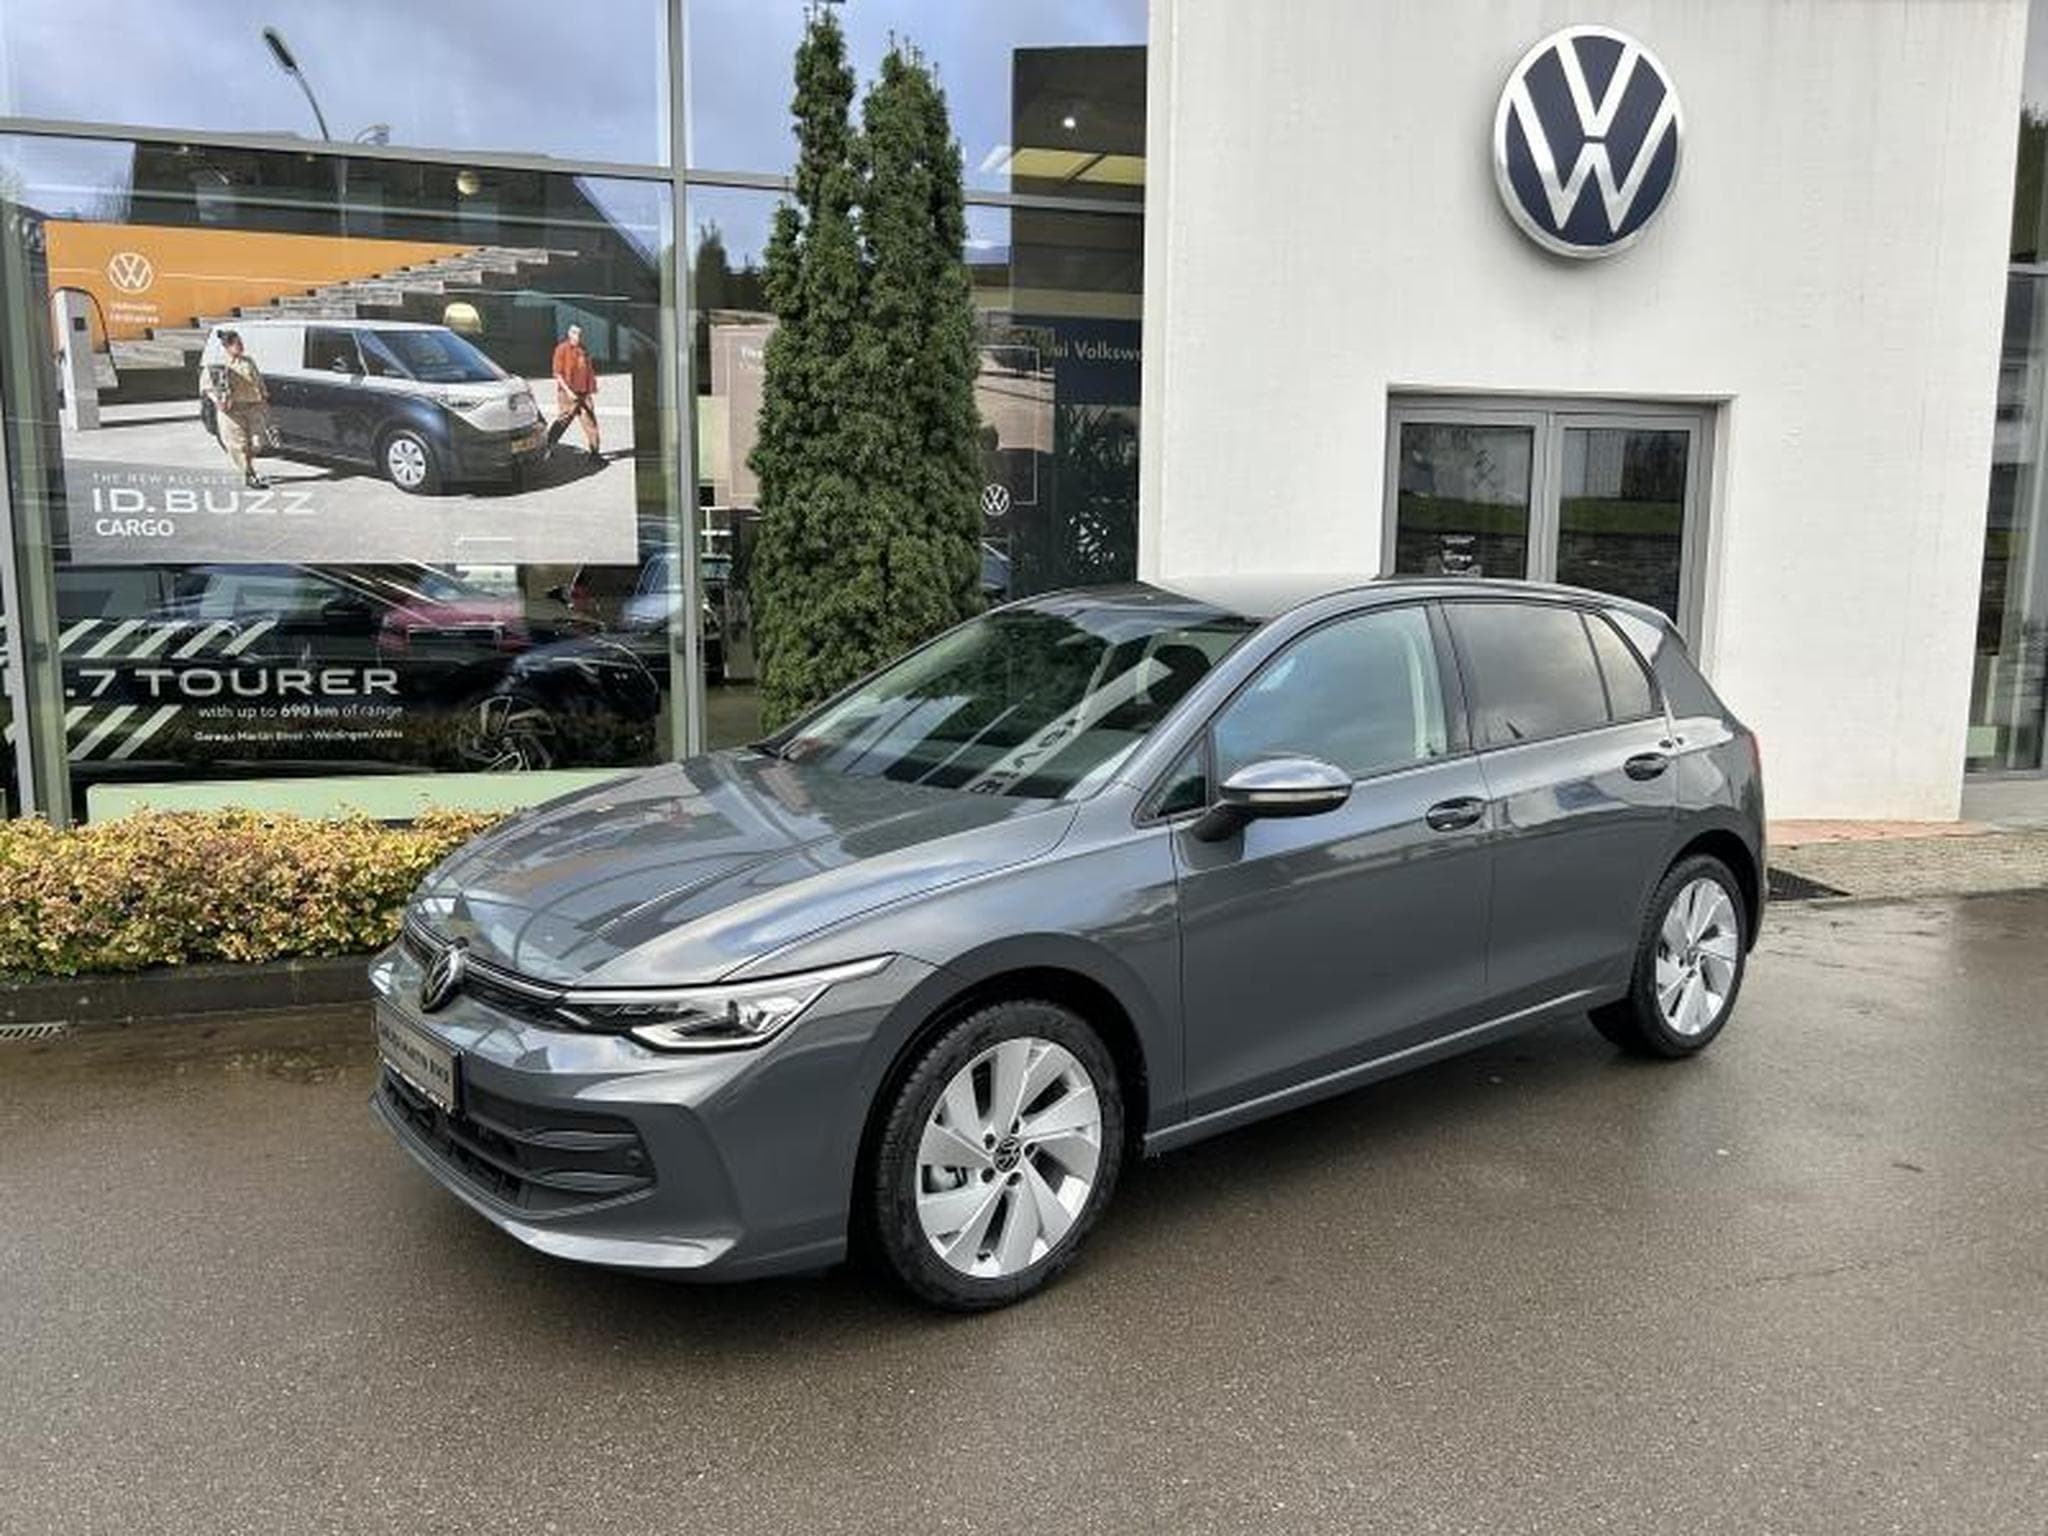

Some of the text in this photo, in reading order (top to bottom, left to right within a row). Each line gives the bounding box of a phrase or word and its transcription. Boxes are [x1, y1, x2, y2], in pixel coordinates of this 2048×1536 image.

[95, 518, 176, 537] CARGO
[134, 668, 401, 697] TOURER
[198, 703, 404, 720] with up to 690 km of range
